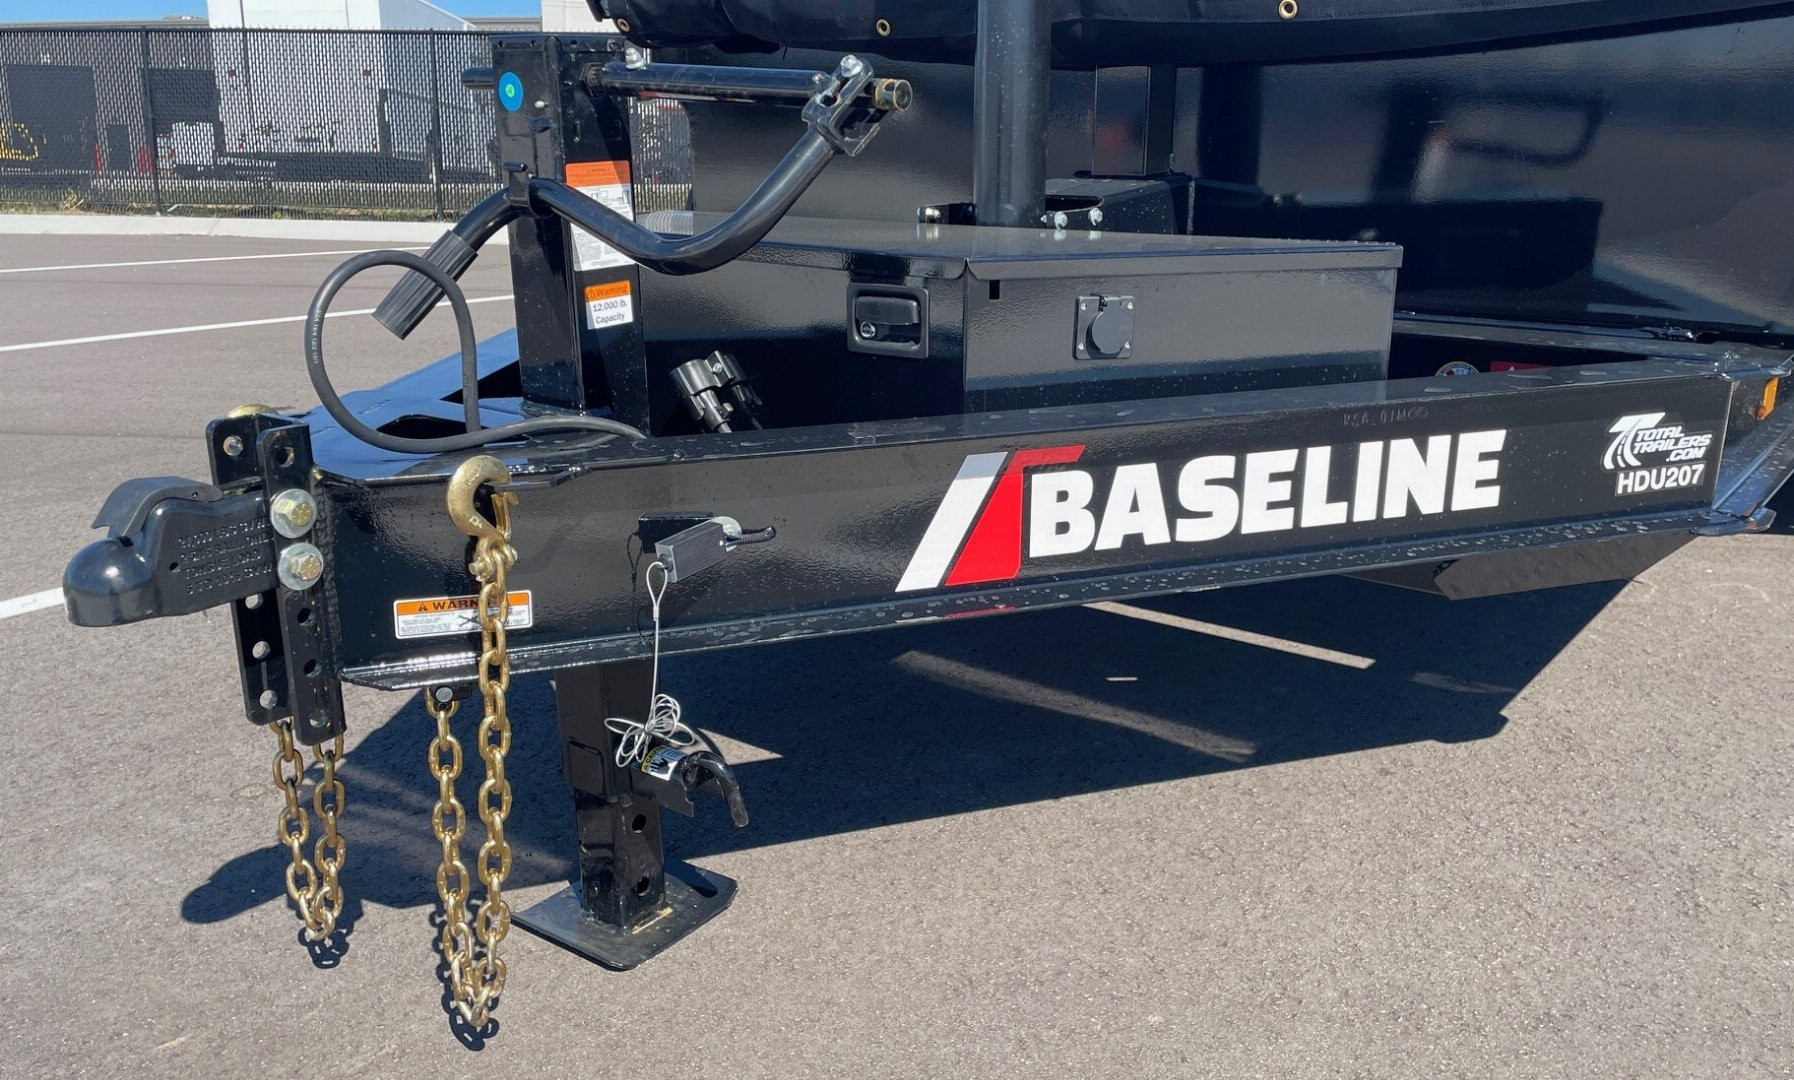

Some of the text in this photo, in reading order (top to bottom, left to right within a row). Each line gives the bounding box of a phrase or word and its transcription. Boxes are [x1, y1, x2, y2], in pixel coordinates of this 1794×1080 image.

[596, 285, 628, 298] Warning
[593, 299, 628, 312] 12,000 lb.
[596, 313, 625, 325] Capacity
[1636, 426, 1685, 442] TOTAL
[1633, 434, 1712, 454] TRAILERS
[1617, 463, 1705, 494] HDU207
[1028, 429, 1507, 558] BASELINE
